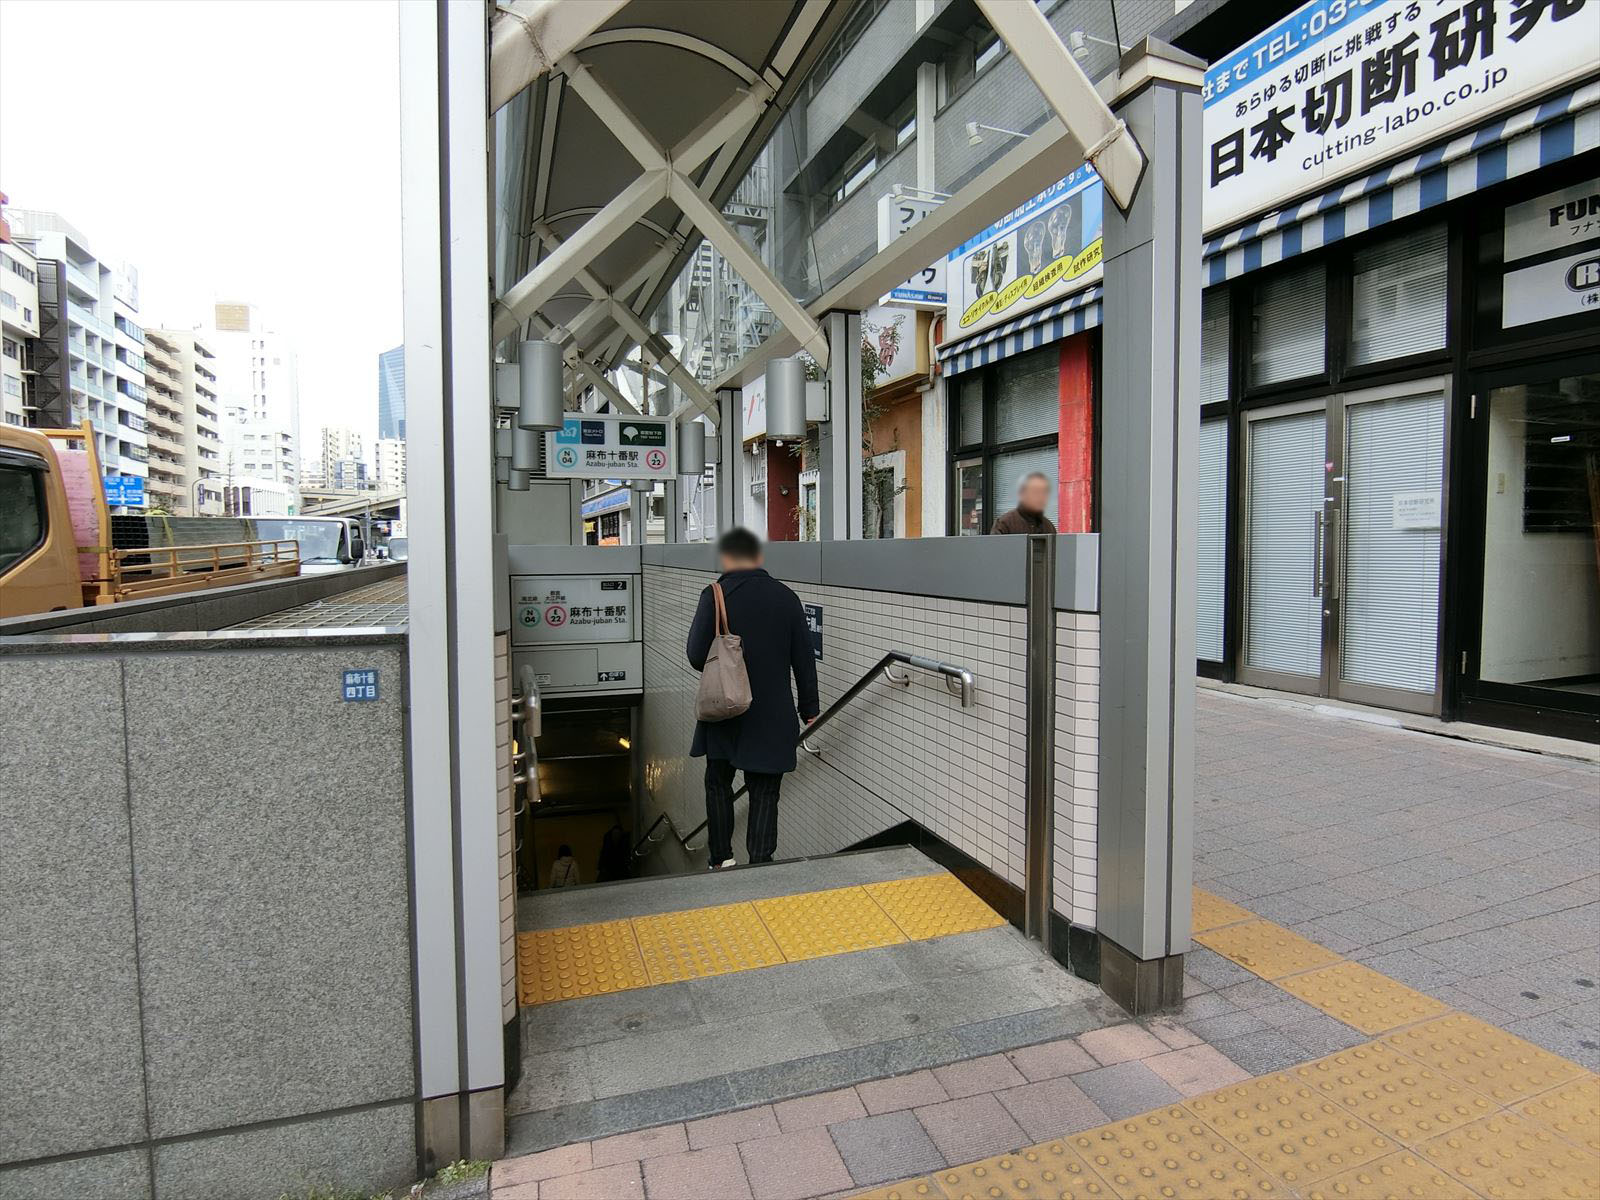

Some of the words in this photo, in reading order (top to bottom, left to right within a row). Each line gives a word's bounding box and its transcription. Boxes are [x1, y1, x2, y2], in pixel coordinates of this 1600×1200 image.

[1252, 0, 1375, 70] TEL:03-
[1235, 0, 1446, 118] あらゆる切断に挑戦する
[1302, 67, 1508, 170] cutting-labo.co.jp
[1570, 220, 1600, 236] フナ
[586, 450, 639, 462] 麻布十番駅
[585, 461, 625, 469] Azabu-juban
[617, 581, 623, 590] 2
[570, 606, 627, 617] 麻布十番駅
[346, 685, 376, 698] 四丁目
